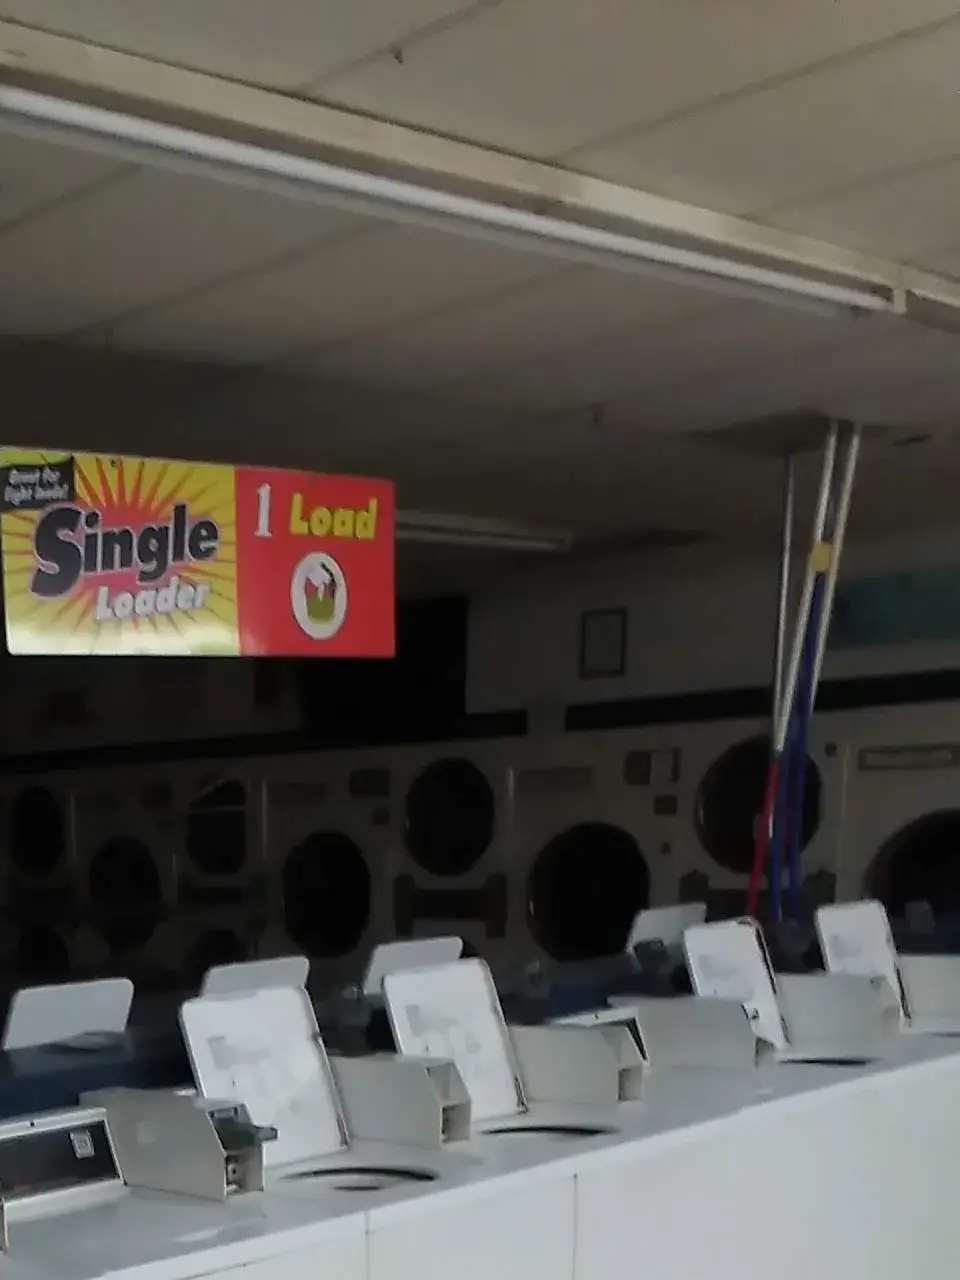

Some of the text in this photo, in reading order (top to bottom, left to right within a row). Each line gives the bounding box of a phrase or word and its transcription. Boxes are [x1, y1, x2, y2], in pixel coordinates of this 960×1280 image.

[254, 483, 378, 539] 1 Load
[30, 503, 219, 597] Single
[96, 575, 211, 620] Loader
